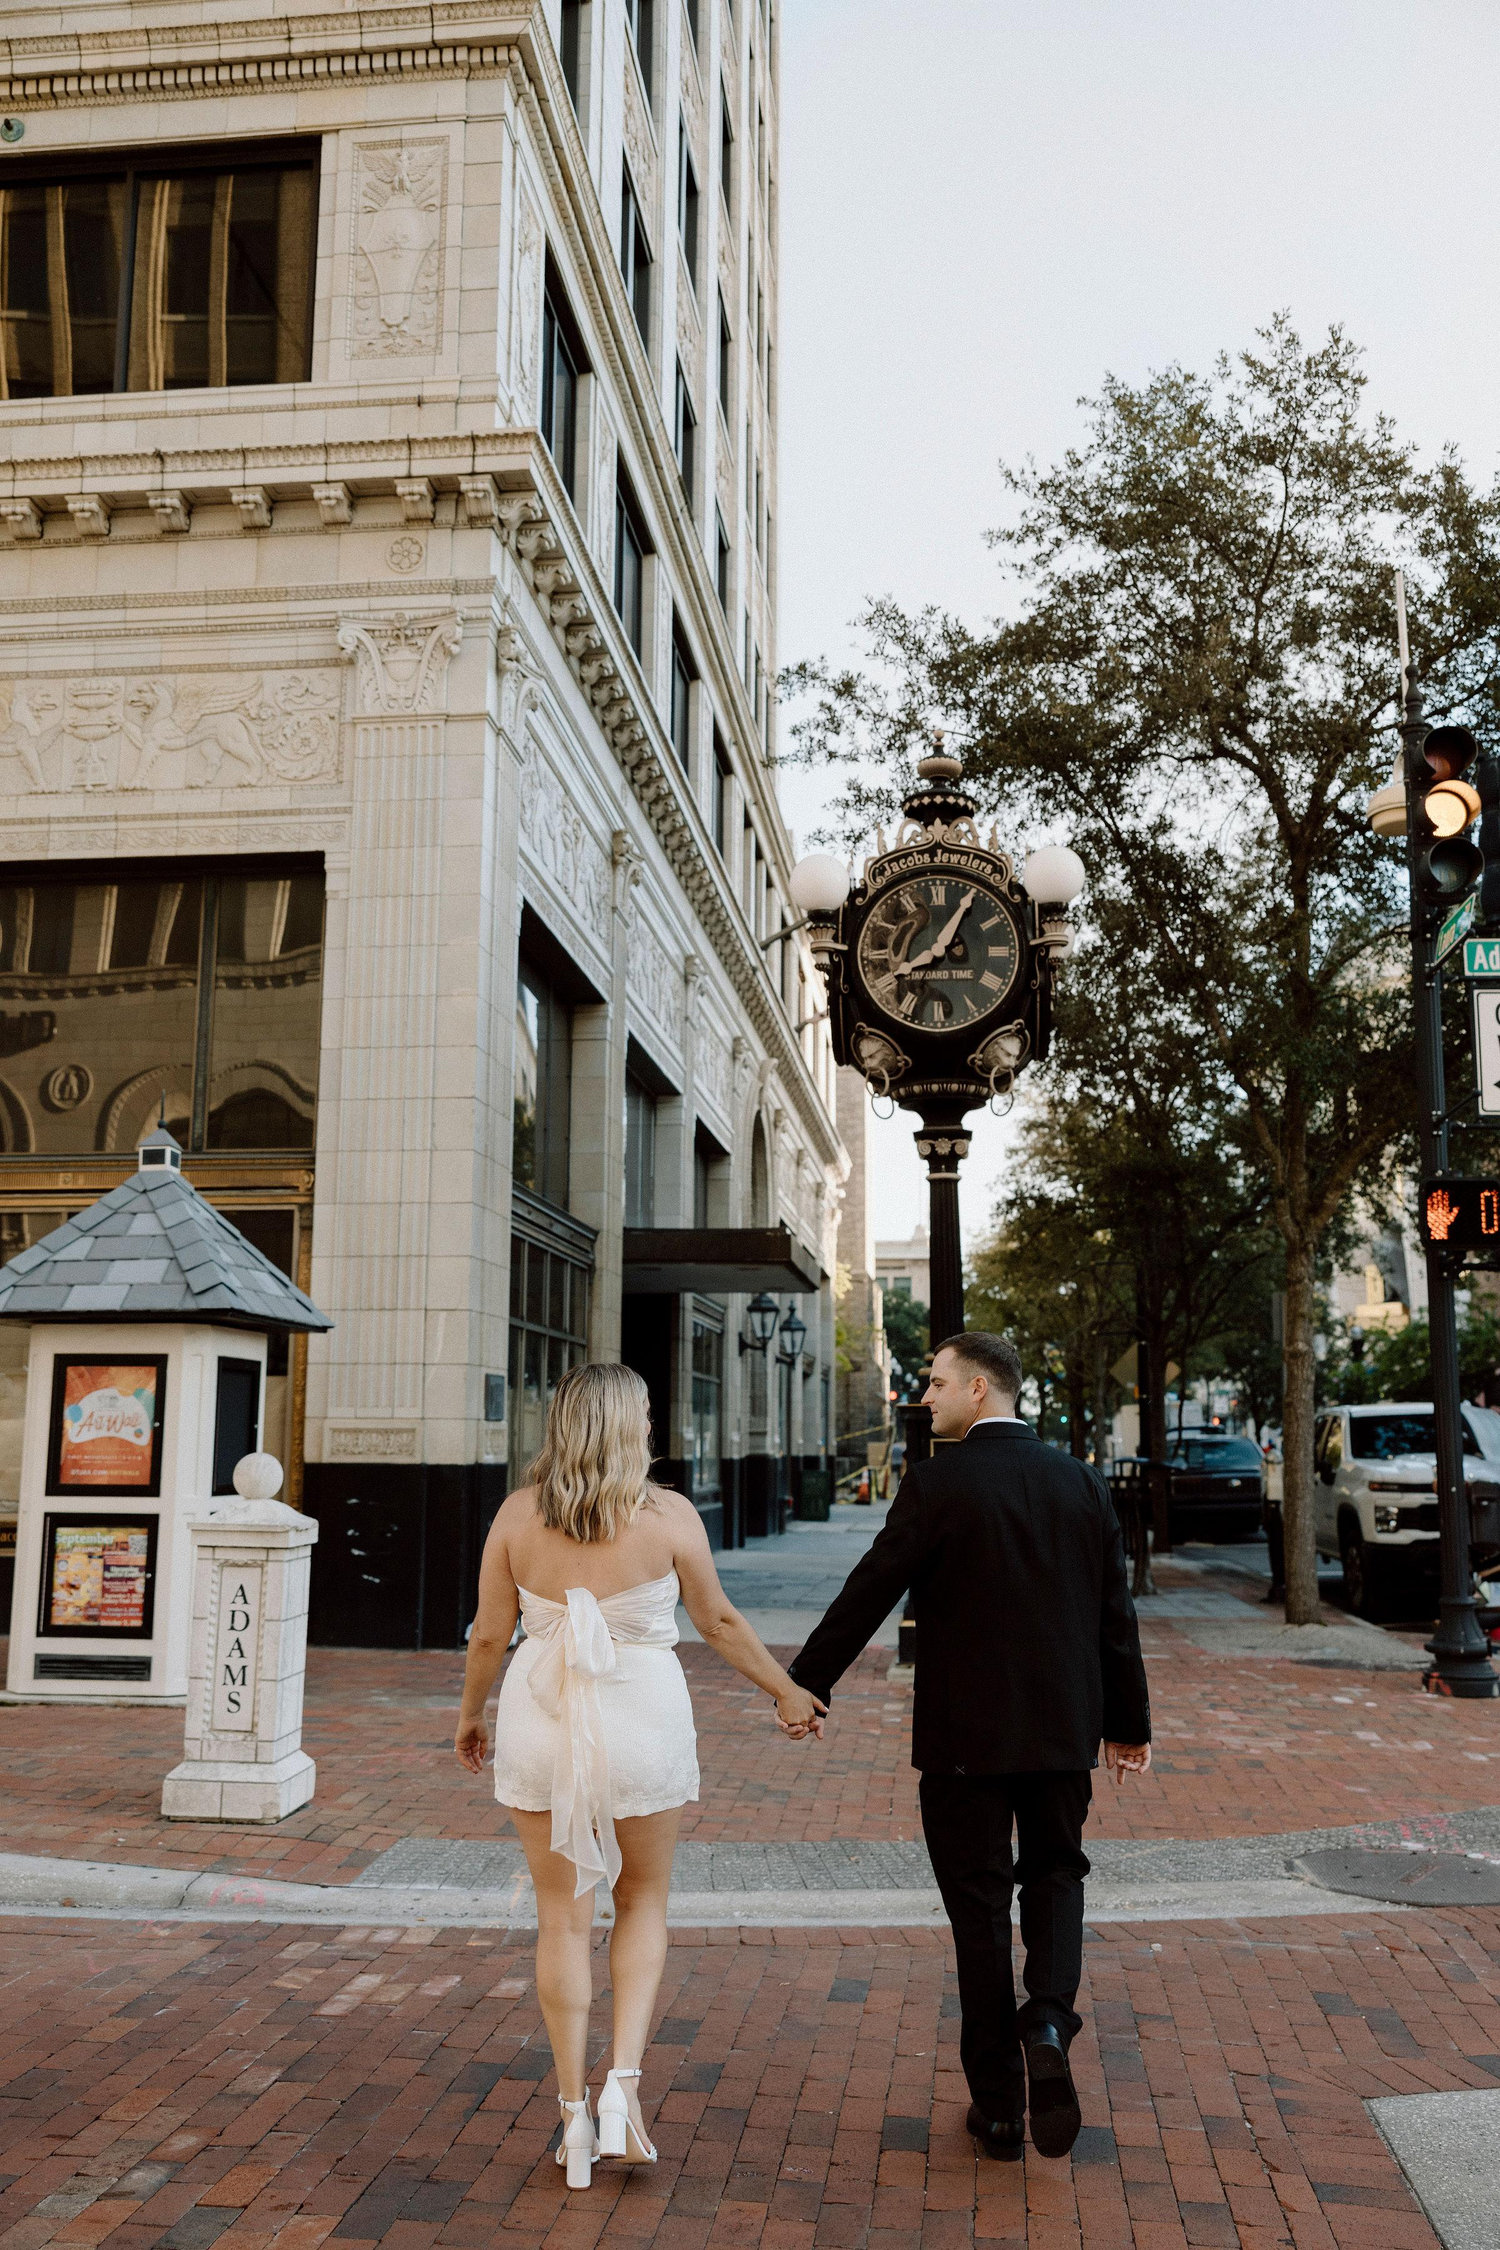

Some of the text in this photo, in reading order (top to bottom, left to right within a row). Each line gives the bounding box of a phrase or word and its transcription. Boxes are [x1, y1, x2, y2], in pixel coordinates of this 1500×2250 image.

[883, 849, 993, 876] Jacobs Jewelers
[1473, 943, 1500, 971] Ad
[952, 969, 974, 980] TIME
[55, 1532, 115, 1547] September
[222, 1584, 251, 1714] ADAMS
